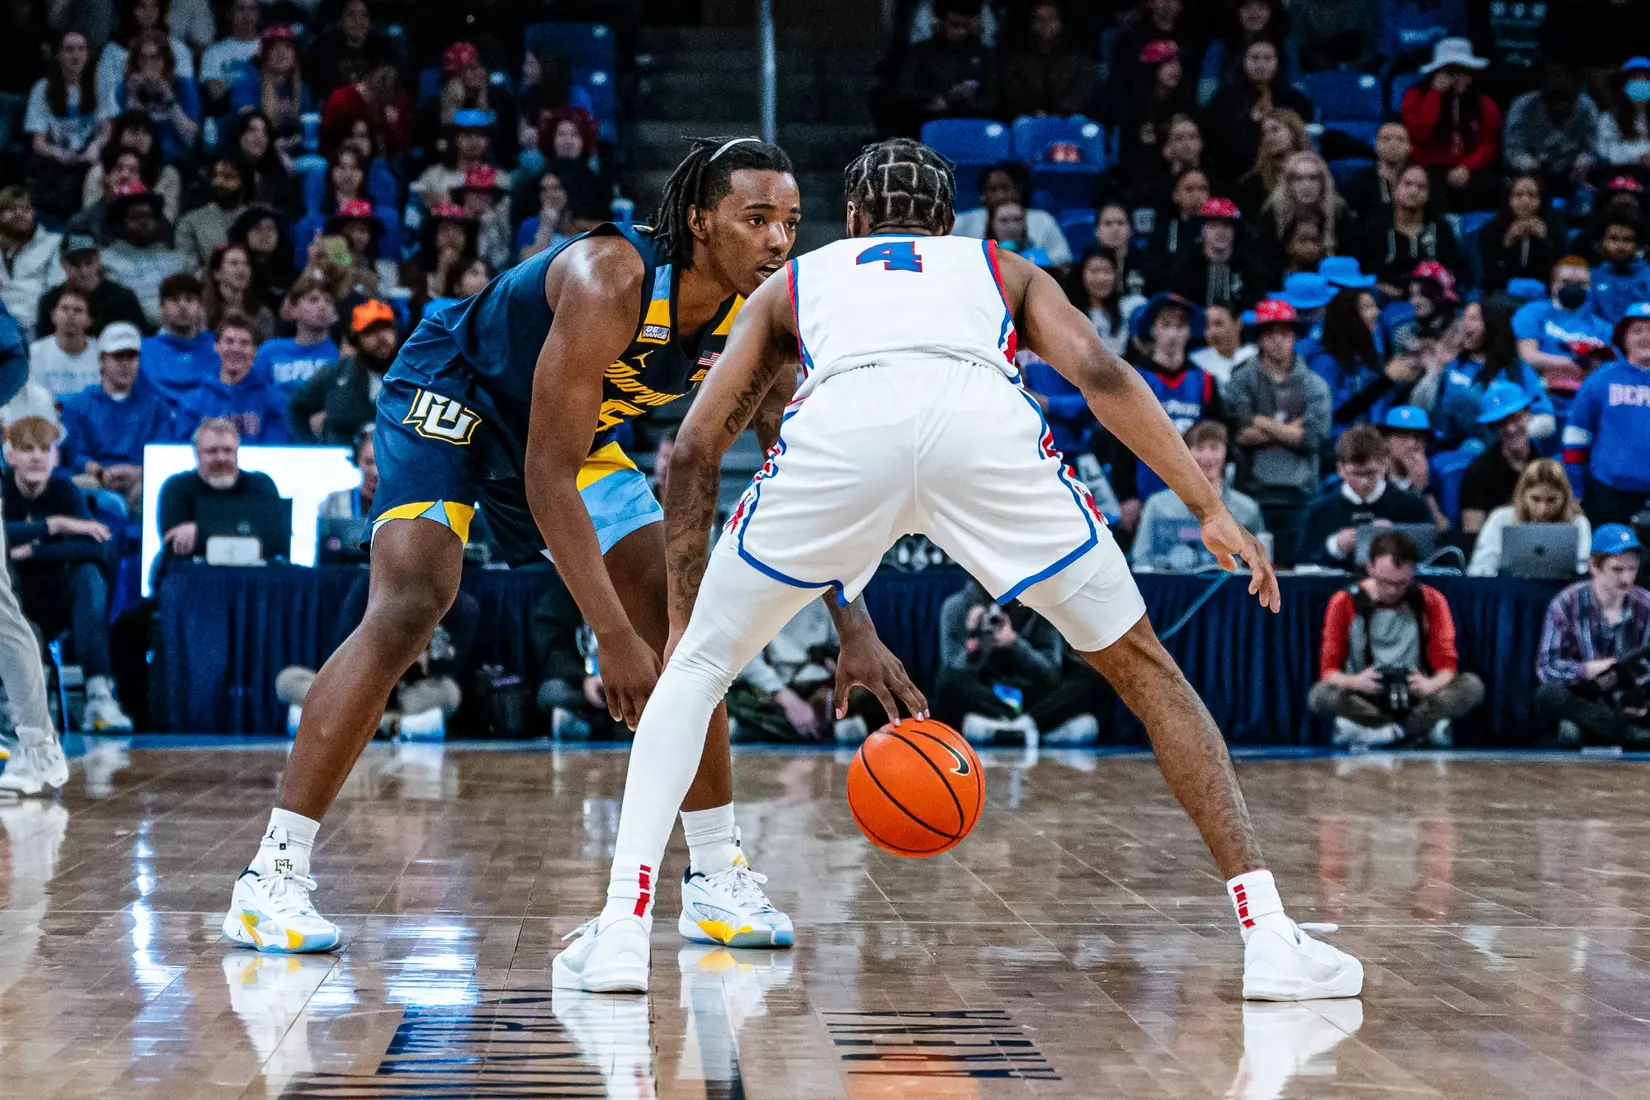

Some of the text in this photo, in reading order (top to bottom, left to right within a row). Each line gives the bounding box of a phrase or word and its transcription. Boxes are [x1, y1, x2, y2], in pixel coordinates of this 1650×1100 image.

[856, 241, 923, 273] 4
[409, 389, 476, 441] MU
[821, 1009, 1063, 1080] ARENA
